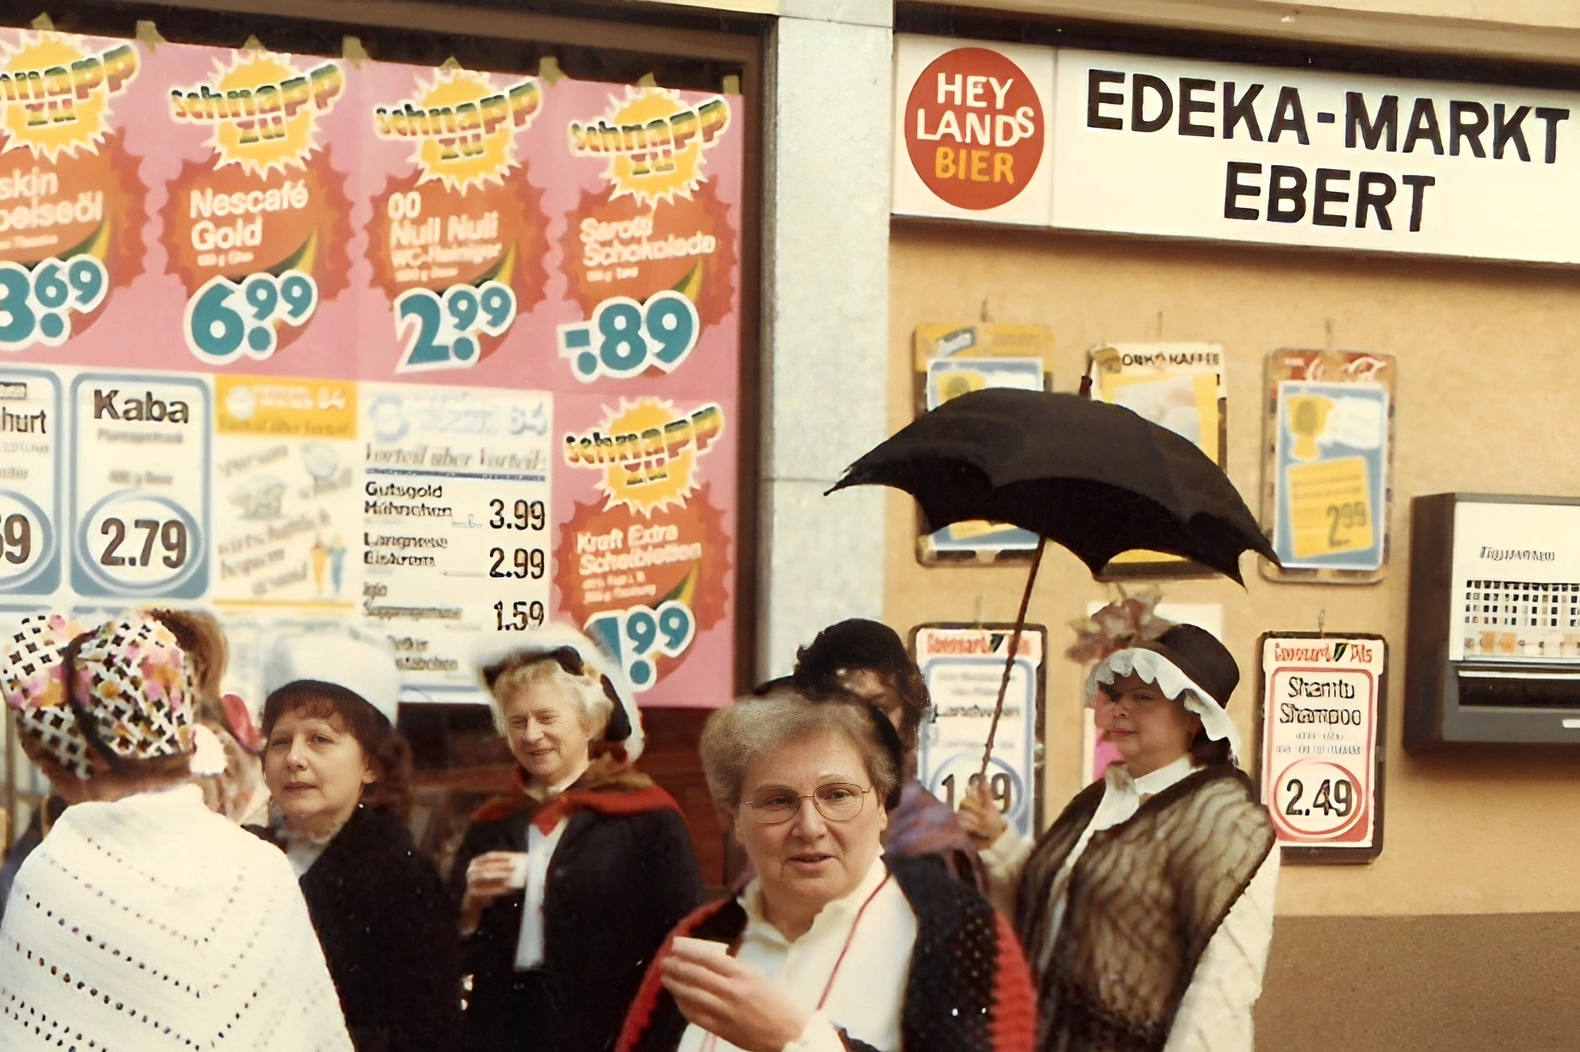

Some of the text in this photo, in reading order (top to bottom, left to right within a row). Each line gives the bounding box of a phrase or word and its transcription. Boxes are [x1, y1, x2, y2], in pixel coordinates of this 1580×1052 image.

[937, 72, 1014, 109] HEY
[916, 106, 1035, 147] LANDS
[1086, 68, 1570, 164] EDEKA-MARKT
[935, 146, 1014, 184] BIER
[1223, 160, 1436, 232] EBERT
[191, 214, 263, 250] Gold
[390, 217, 441, 247] Null
[93, 389, 189, 424] Kaba
[489, 498, 546, 531] 3.99
[100, 517, 187, 568] 2.79
[489, 547, 545, 579] 2.99
[494, 600, 545, 631] 1.59
[1285, 778, 1353, 817] 2.49
